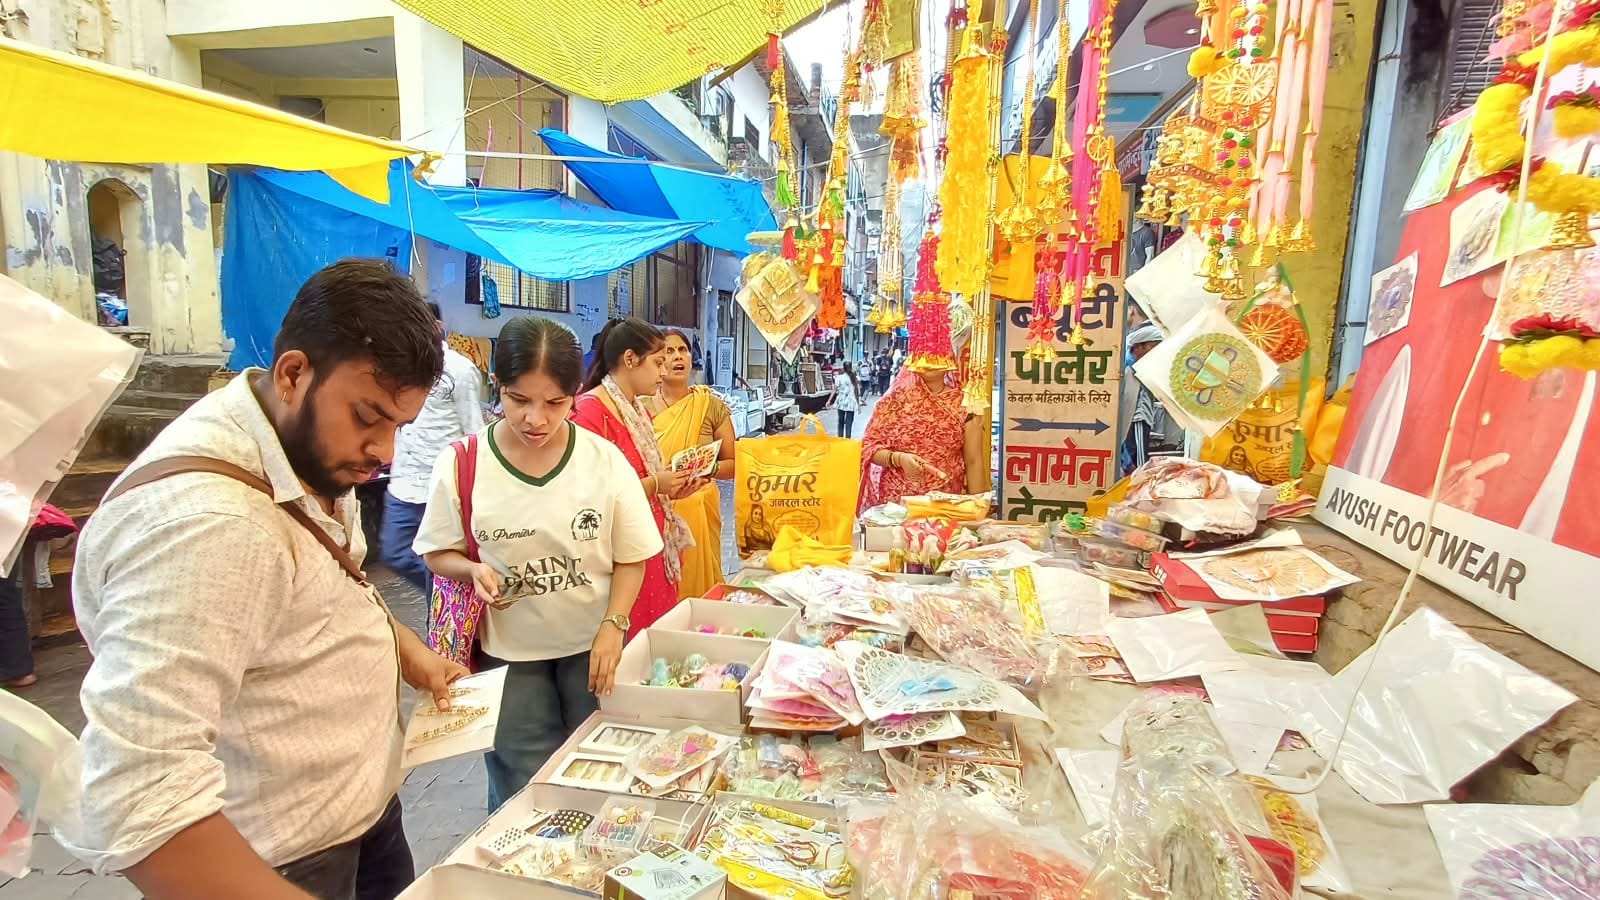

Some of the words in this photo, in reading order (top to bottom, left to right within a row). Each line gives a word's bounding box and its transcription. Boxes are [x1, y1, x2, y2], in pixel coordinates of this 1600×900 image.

[1008, 389, 1033, 404] केवल
[747, 471, 819, 502] कुमार
[477, 530, 490, 542] La
[1325, 487, 1383, 532] AYUSH
[1379, 509, 1527, 601] FOOTWEAR
